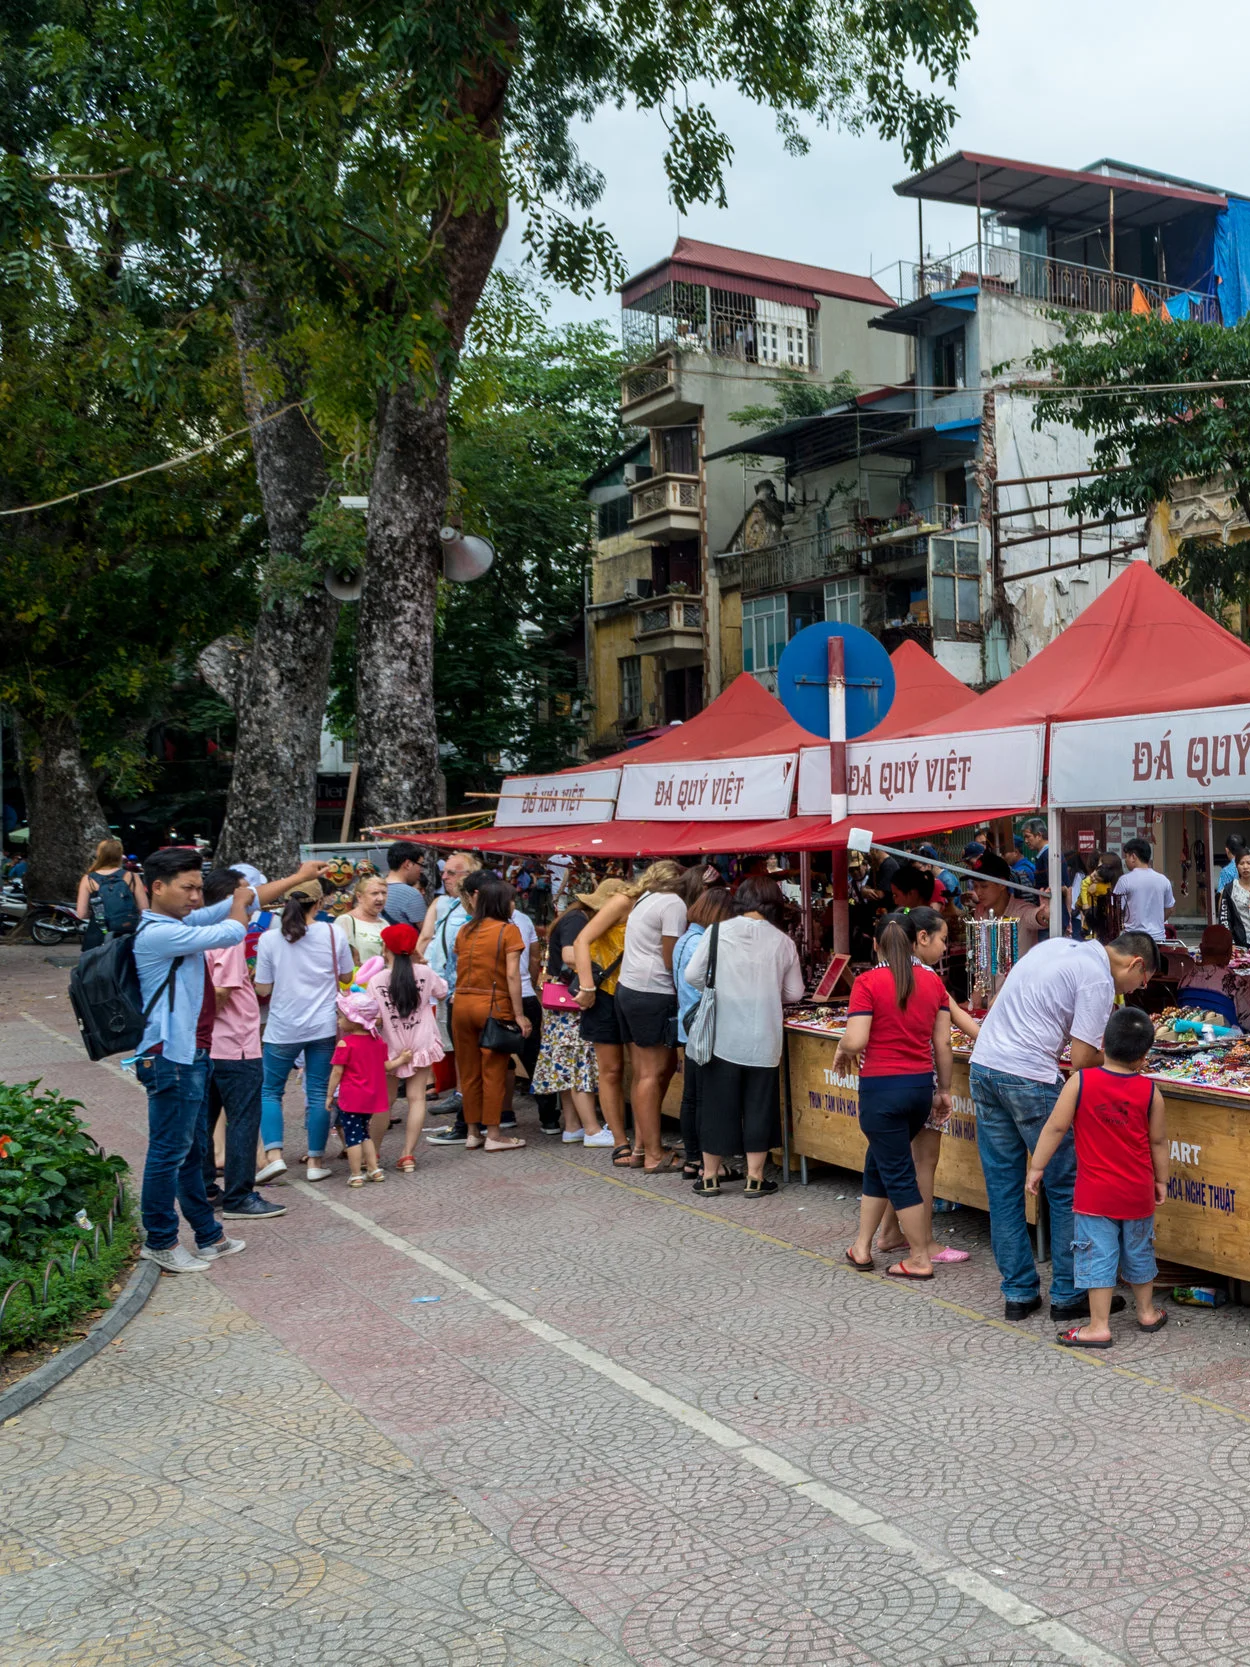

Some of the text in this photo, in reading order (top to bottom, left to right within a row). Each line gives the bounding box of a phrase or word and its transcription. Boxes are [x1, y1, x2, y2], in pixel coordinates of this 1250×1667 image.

[848, 749, 972, 802] ĐÁ QUÝ VIỆT
[1132, 729, 1174, 781] ĐÁ
[654, 771, 744, 812] ĐÁ QUÝ VIỆT
